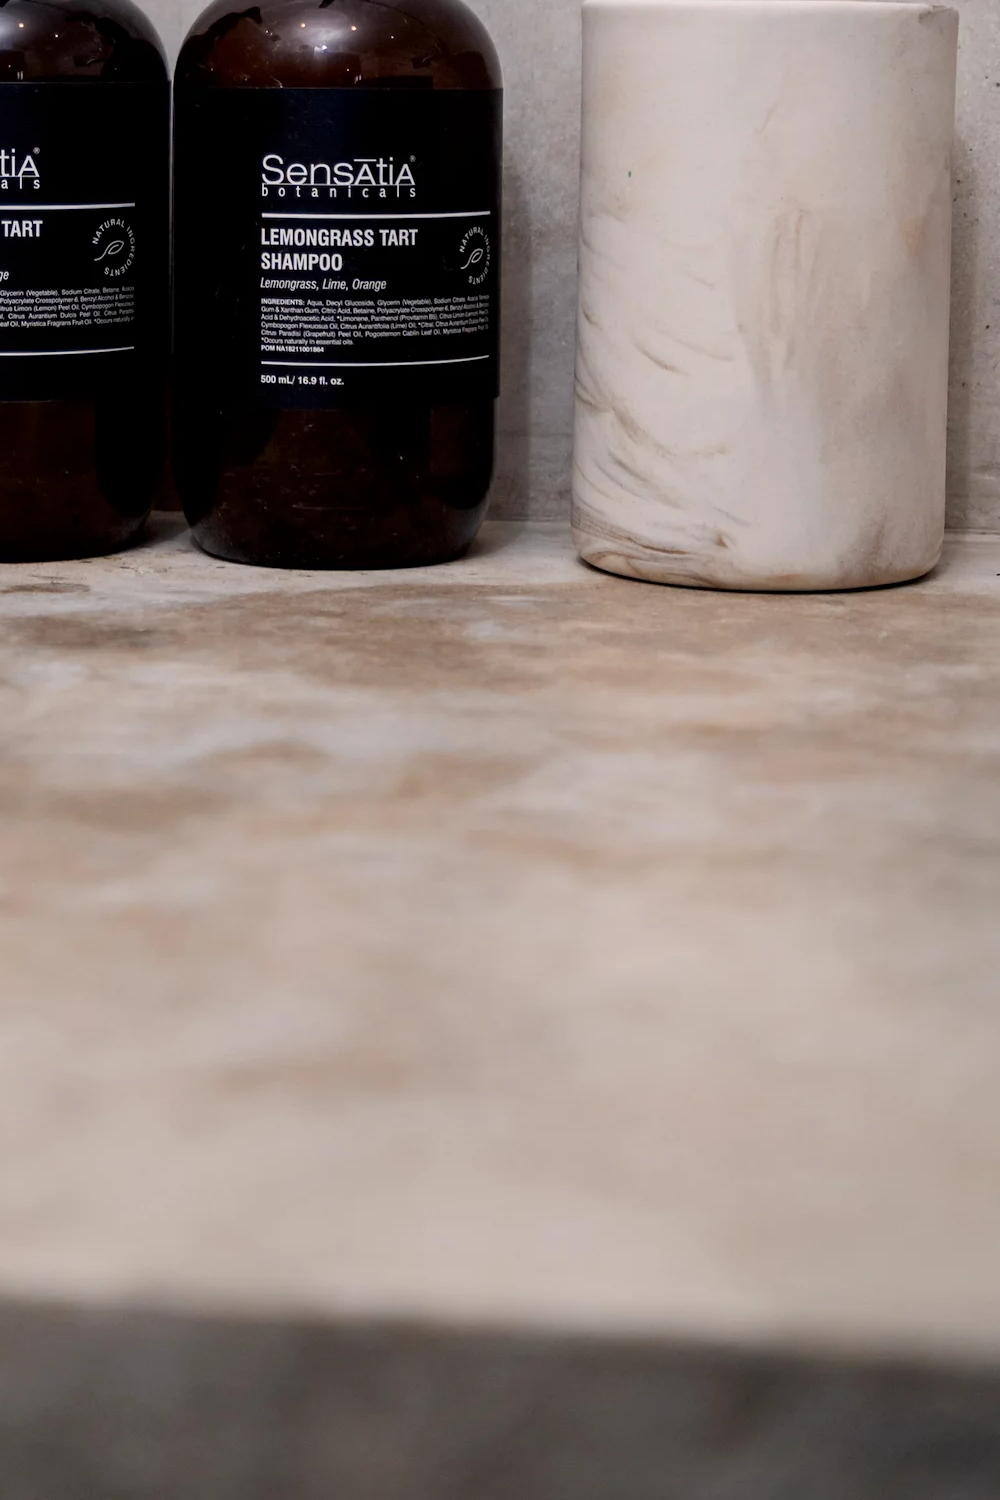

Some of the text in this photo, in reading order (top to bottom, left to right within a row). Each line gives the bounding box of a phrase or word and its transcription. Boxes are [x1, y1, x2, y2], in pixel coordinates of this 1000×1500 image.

[262, 183, 416, 198] botanicals
[1, 220, 43, 237] TART
[261, 228, 418, 246] LEMONGRASS TART
[460, 226, 483, 253] NATURAL
[92, 218, 135, 276] NATURAL INGREDIENTS
[261, 252, 343, 271] SHAMPOO
[260, 277, 386, 292] Lemongrass, Lime, Orange
[261, 298, 305, 306] INGREDIENTS:
[47, 320, 71, 328] Fragrans
[261, 321, 298, 330] Cymbopogon
[279, 314, 320, 322] Dehydroacetic
[261, 375, 276, 384] 500
[278, 375, 296, 385] mL/
[298, 376, 317, 385] 16.9
[319, 376, 328, 385] fl.
